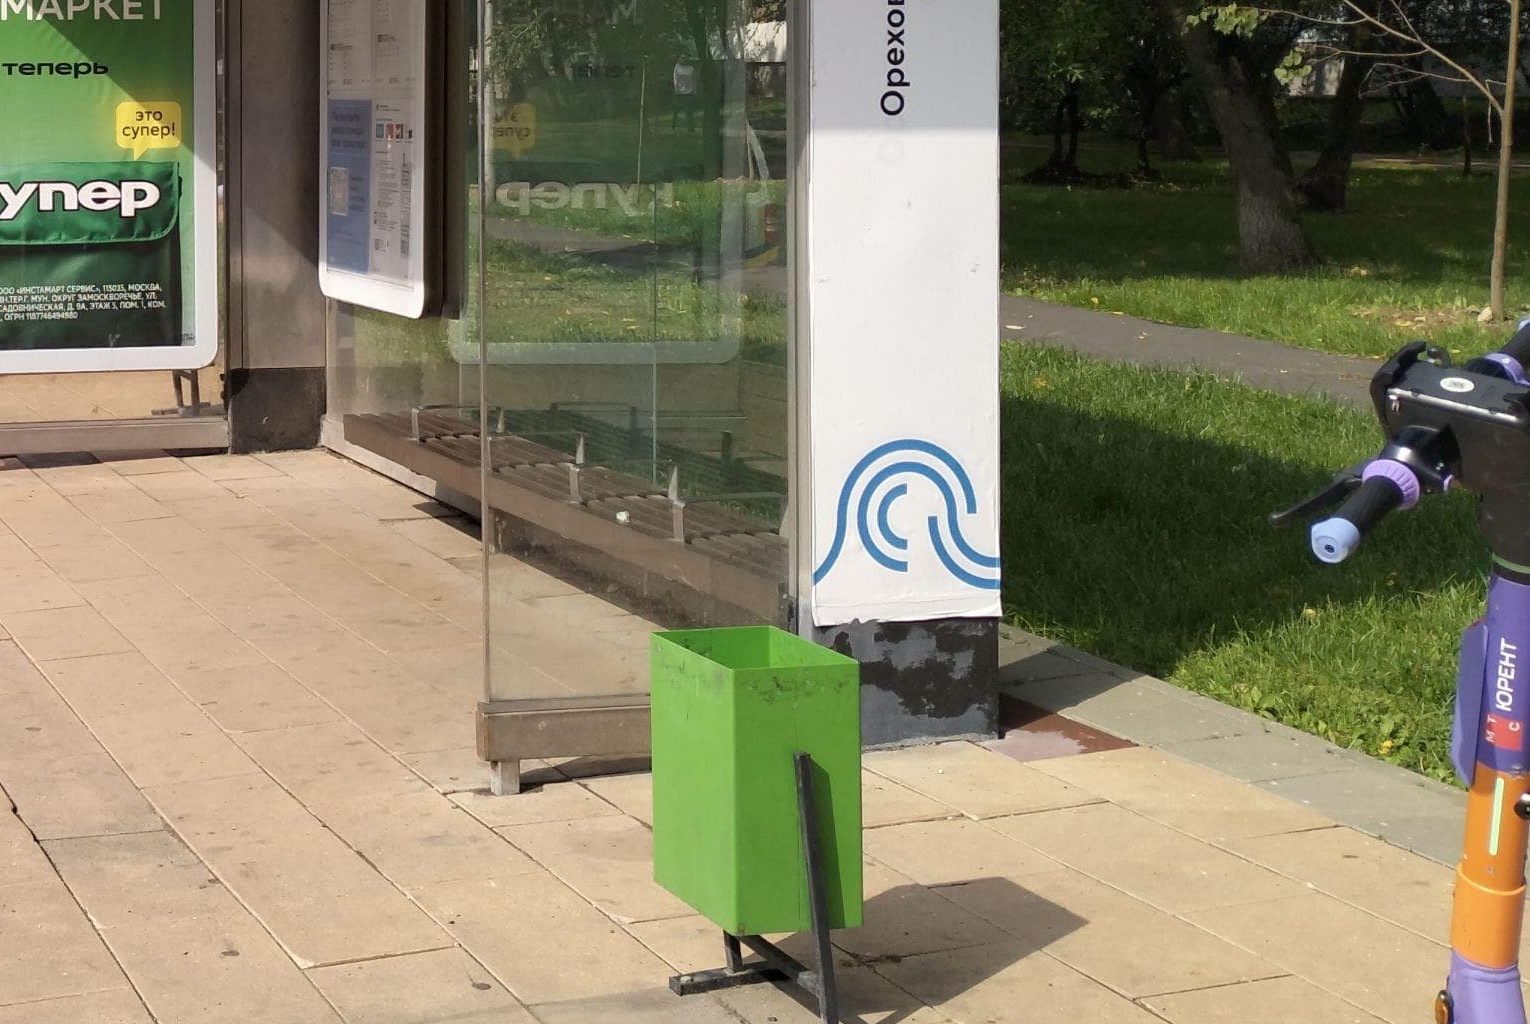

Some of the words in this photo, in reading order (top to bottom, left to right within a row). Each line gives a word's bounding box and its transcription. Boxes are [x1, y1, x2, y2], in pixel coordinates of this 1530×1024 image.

[1, 61, 109, 79] теперь
[135, 110, 163, 122] это
[121, 122, 176, 139] супер!
[128, 282, 162, 292] МОСКВА,
[51, 293, 76, 303] ОКРУГ
[89, 301, 111, 310] ЭТАЖ
[119, 301, 140, 309] ПОМ.
[3, 312, 25, 321] ОГРН
[1494, 637, 1518, 712] ЮРЕНТ
